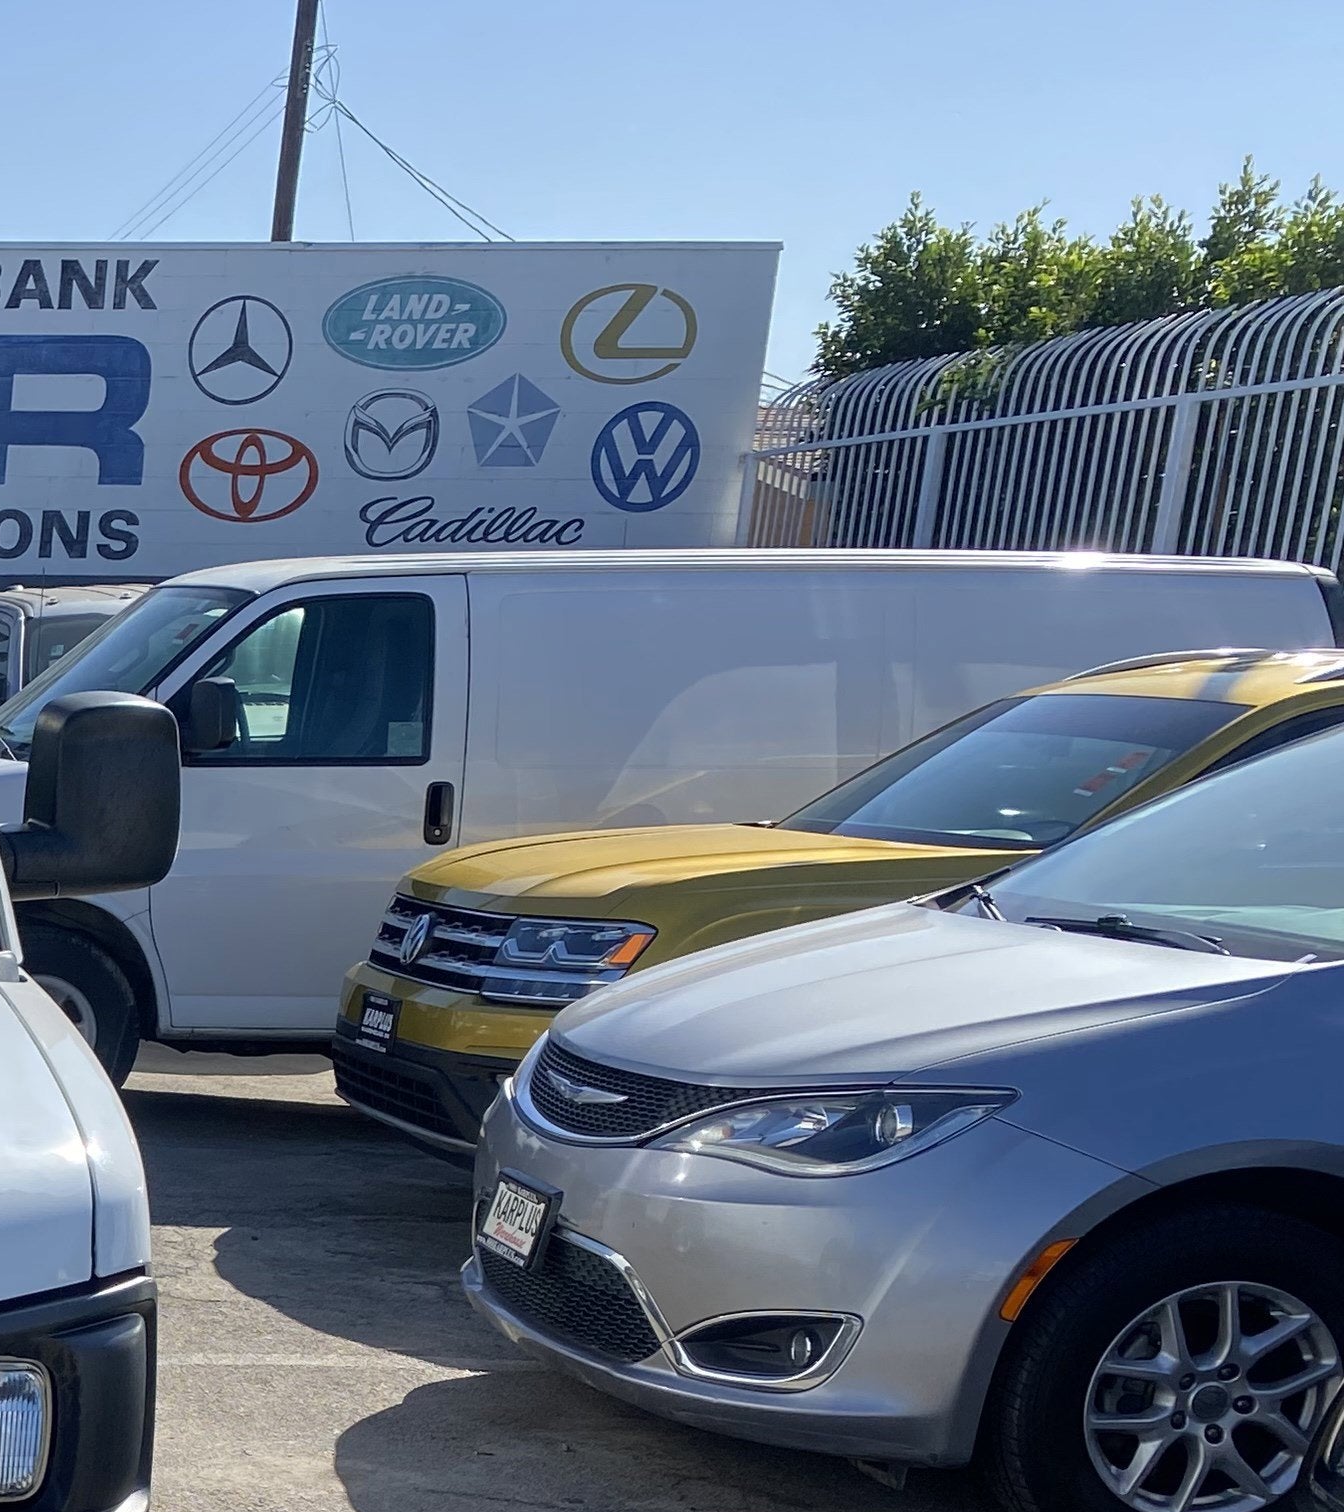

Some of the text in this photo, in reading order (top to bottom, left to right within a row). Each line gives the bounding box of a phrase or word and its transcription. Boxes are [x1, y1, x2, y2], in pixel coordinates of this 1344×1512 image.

[361, 293, 451, 321] LAND
[366, 322, 477, 351] ROVER
[358, 495, 585, 549] Cadillac
[493, 1189, 542, 1237] KARPLUS
